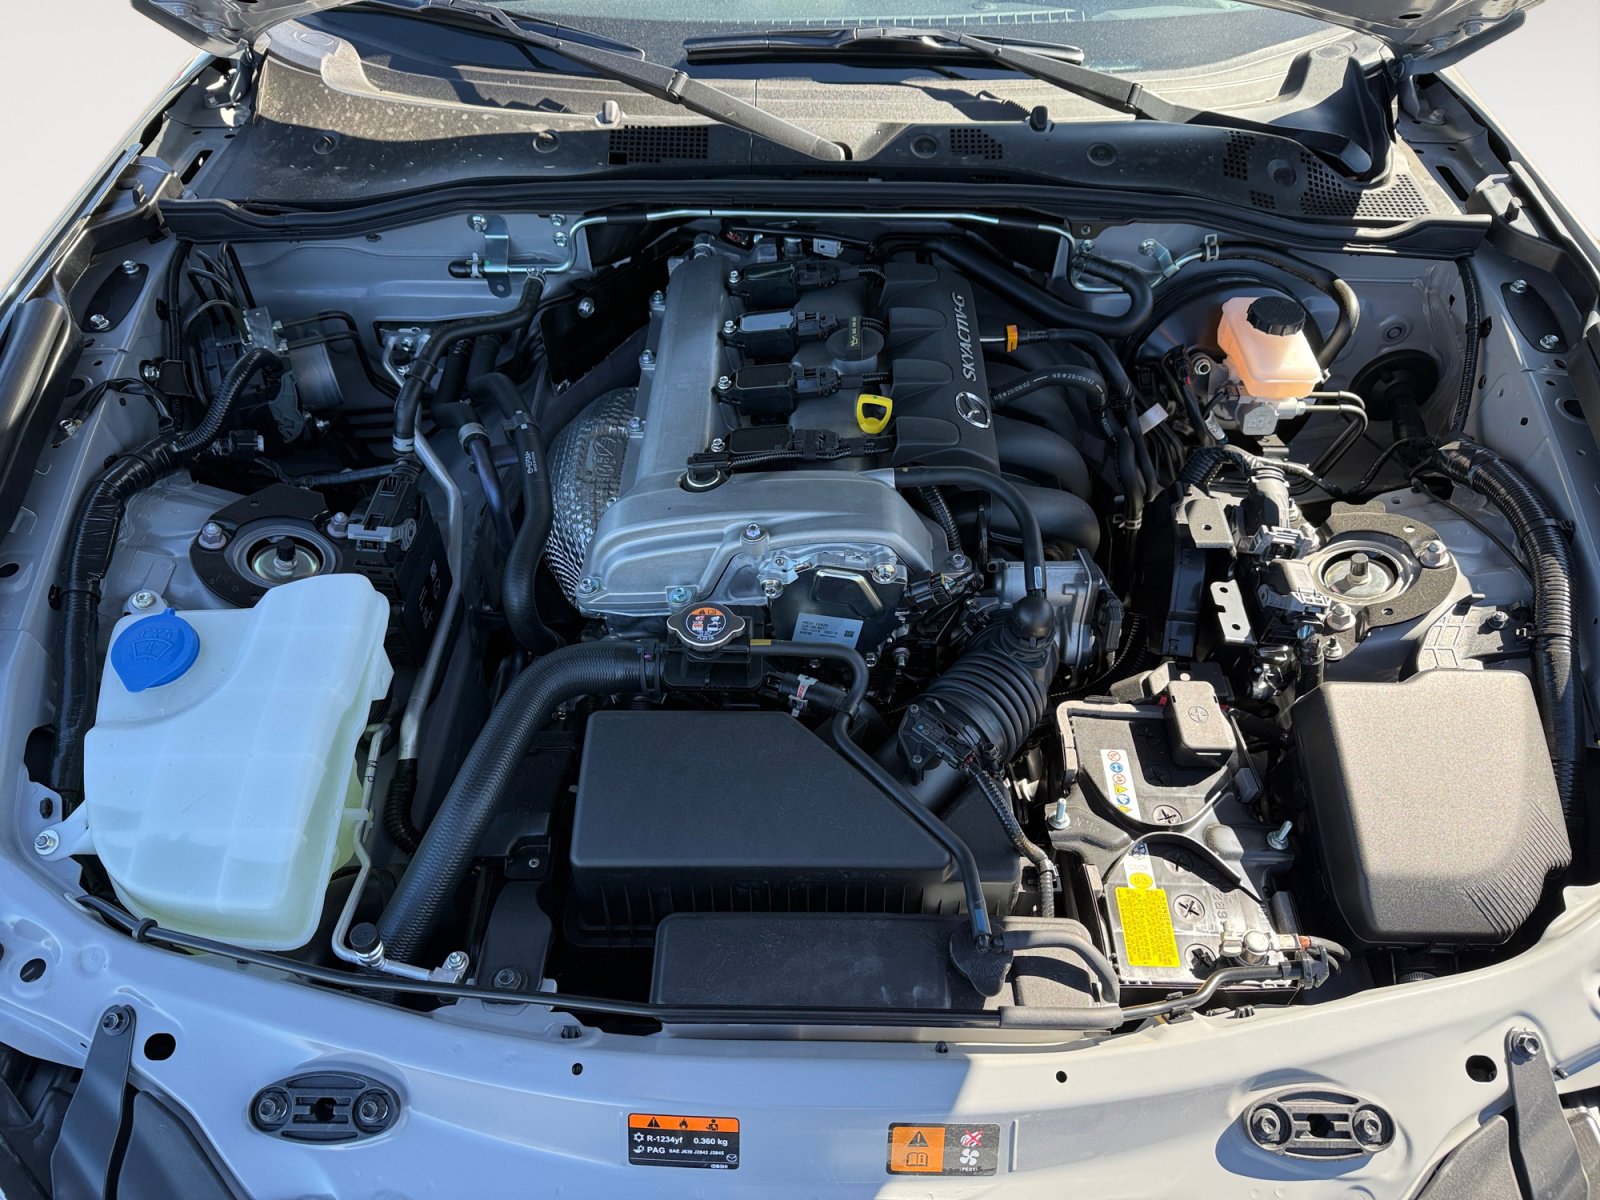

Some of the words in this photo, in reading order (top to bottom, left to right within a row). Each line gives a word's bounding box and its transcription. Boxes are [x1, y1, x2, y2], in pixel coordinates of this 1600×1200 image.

[952, 292, 976, 381] SKYACTIV-G
[646, 1135, 683, 1144] R-1234yf
[717, 1138, 728, 1146] kg
[647, 1146, 665, 1154] PAG
